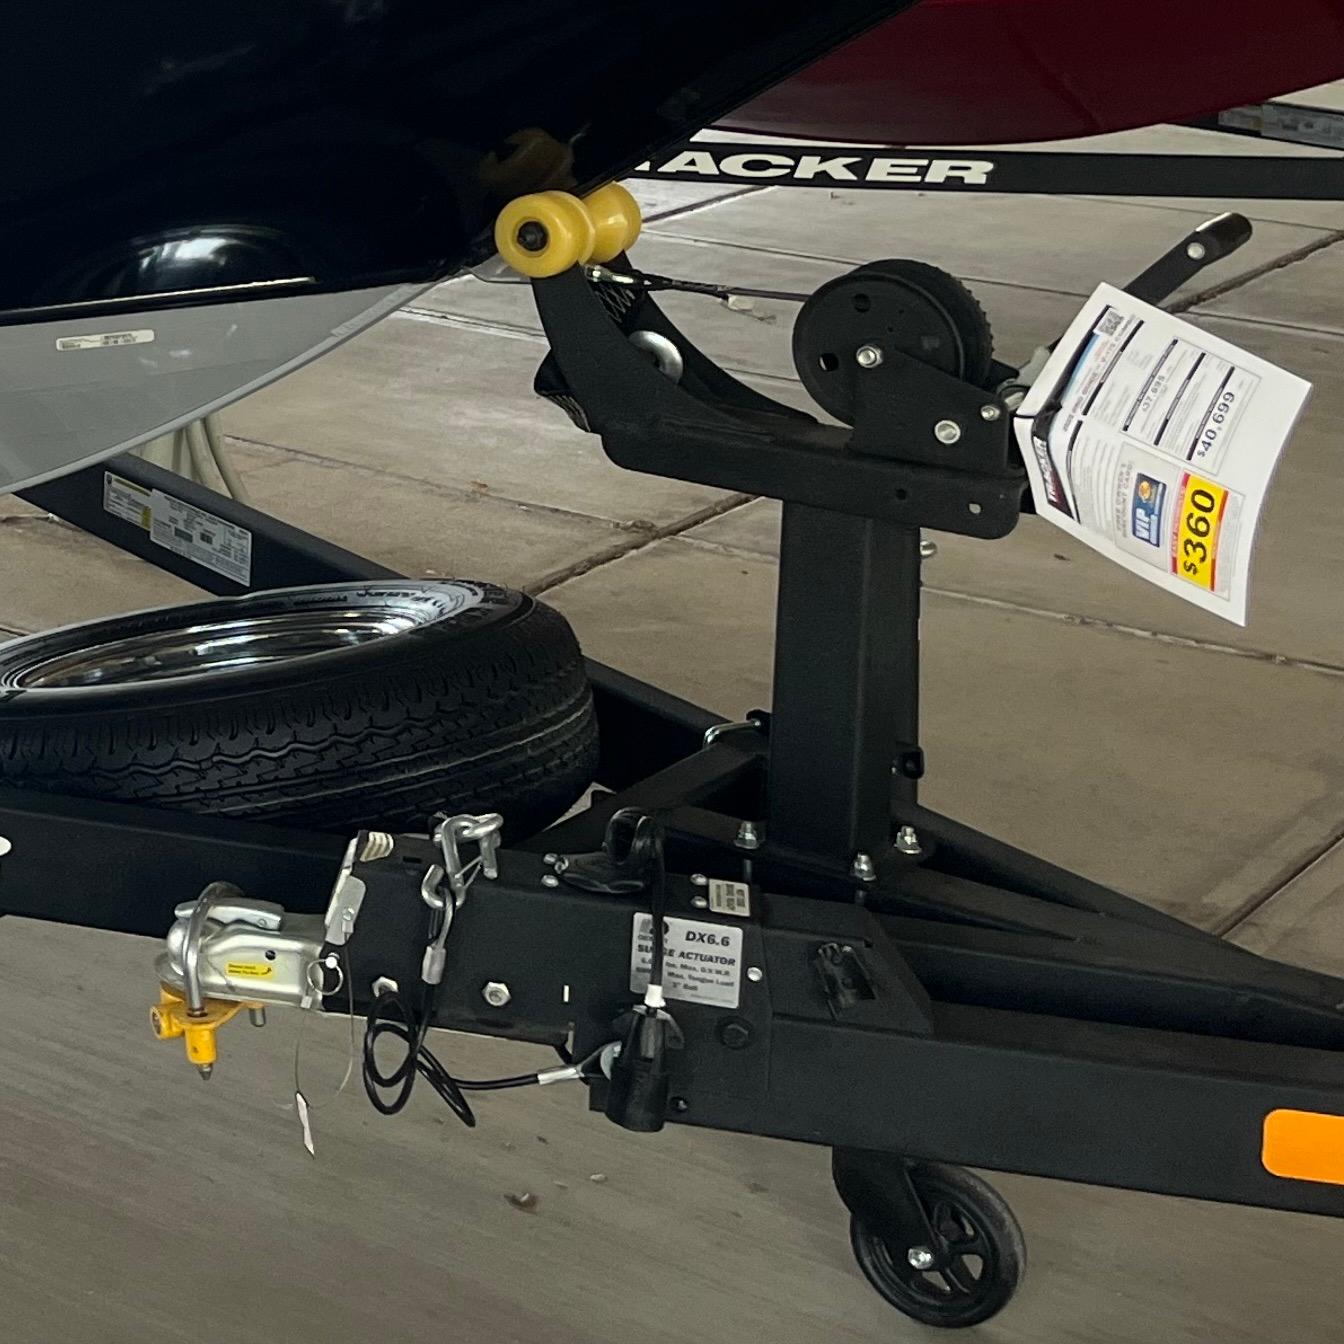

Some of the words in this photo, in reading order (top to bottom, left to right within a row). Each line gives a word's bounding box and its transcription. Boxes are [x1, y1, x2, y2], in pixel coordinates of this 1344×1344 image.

[635, 151, 994, 185] ACKER
[1197, 391, 1236, 457] $40,699
[1183, 488, 1215, 575] $360
[685, 930, 730, 947] DX6.6
[678, 951, 736, 966] ACTUATOR
